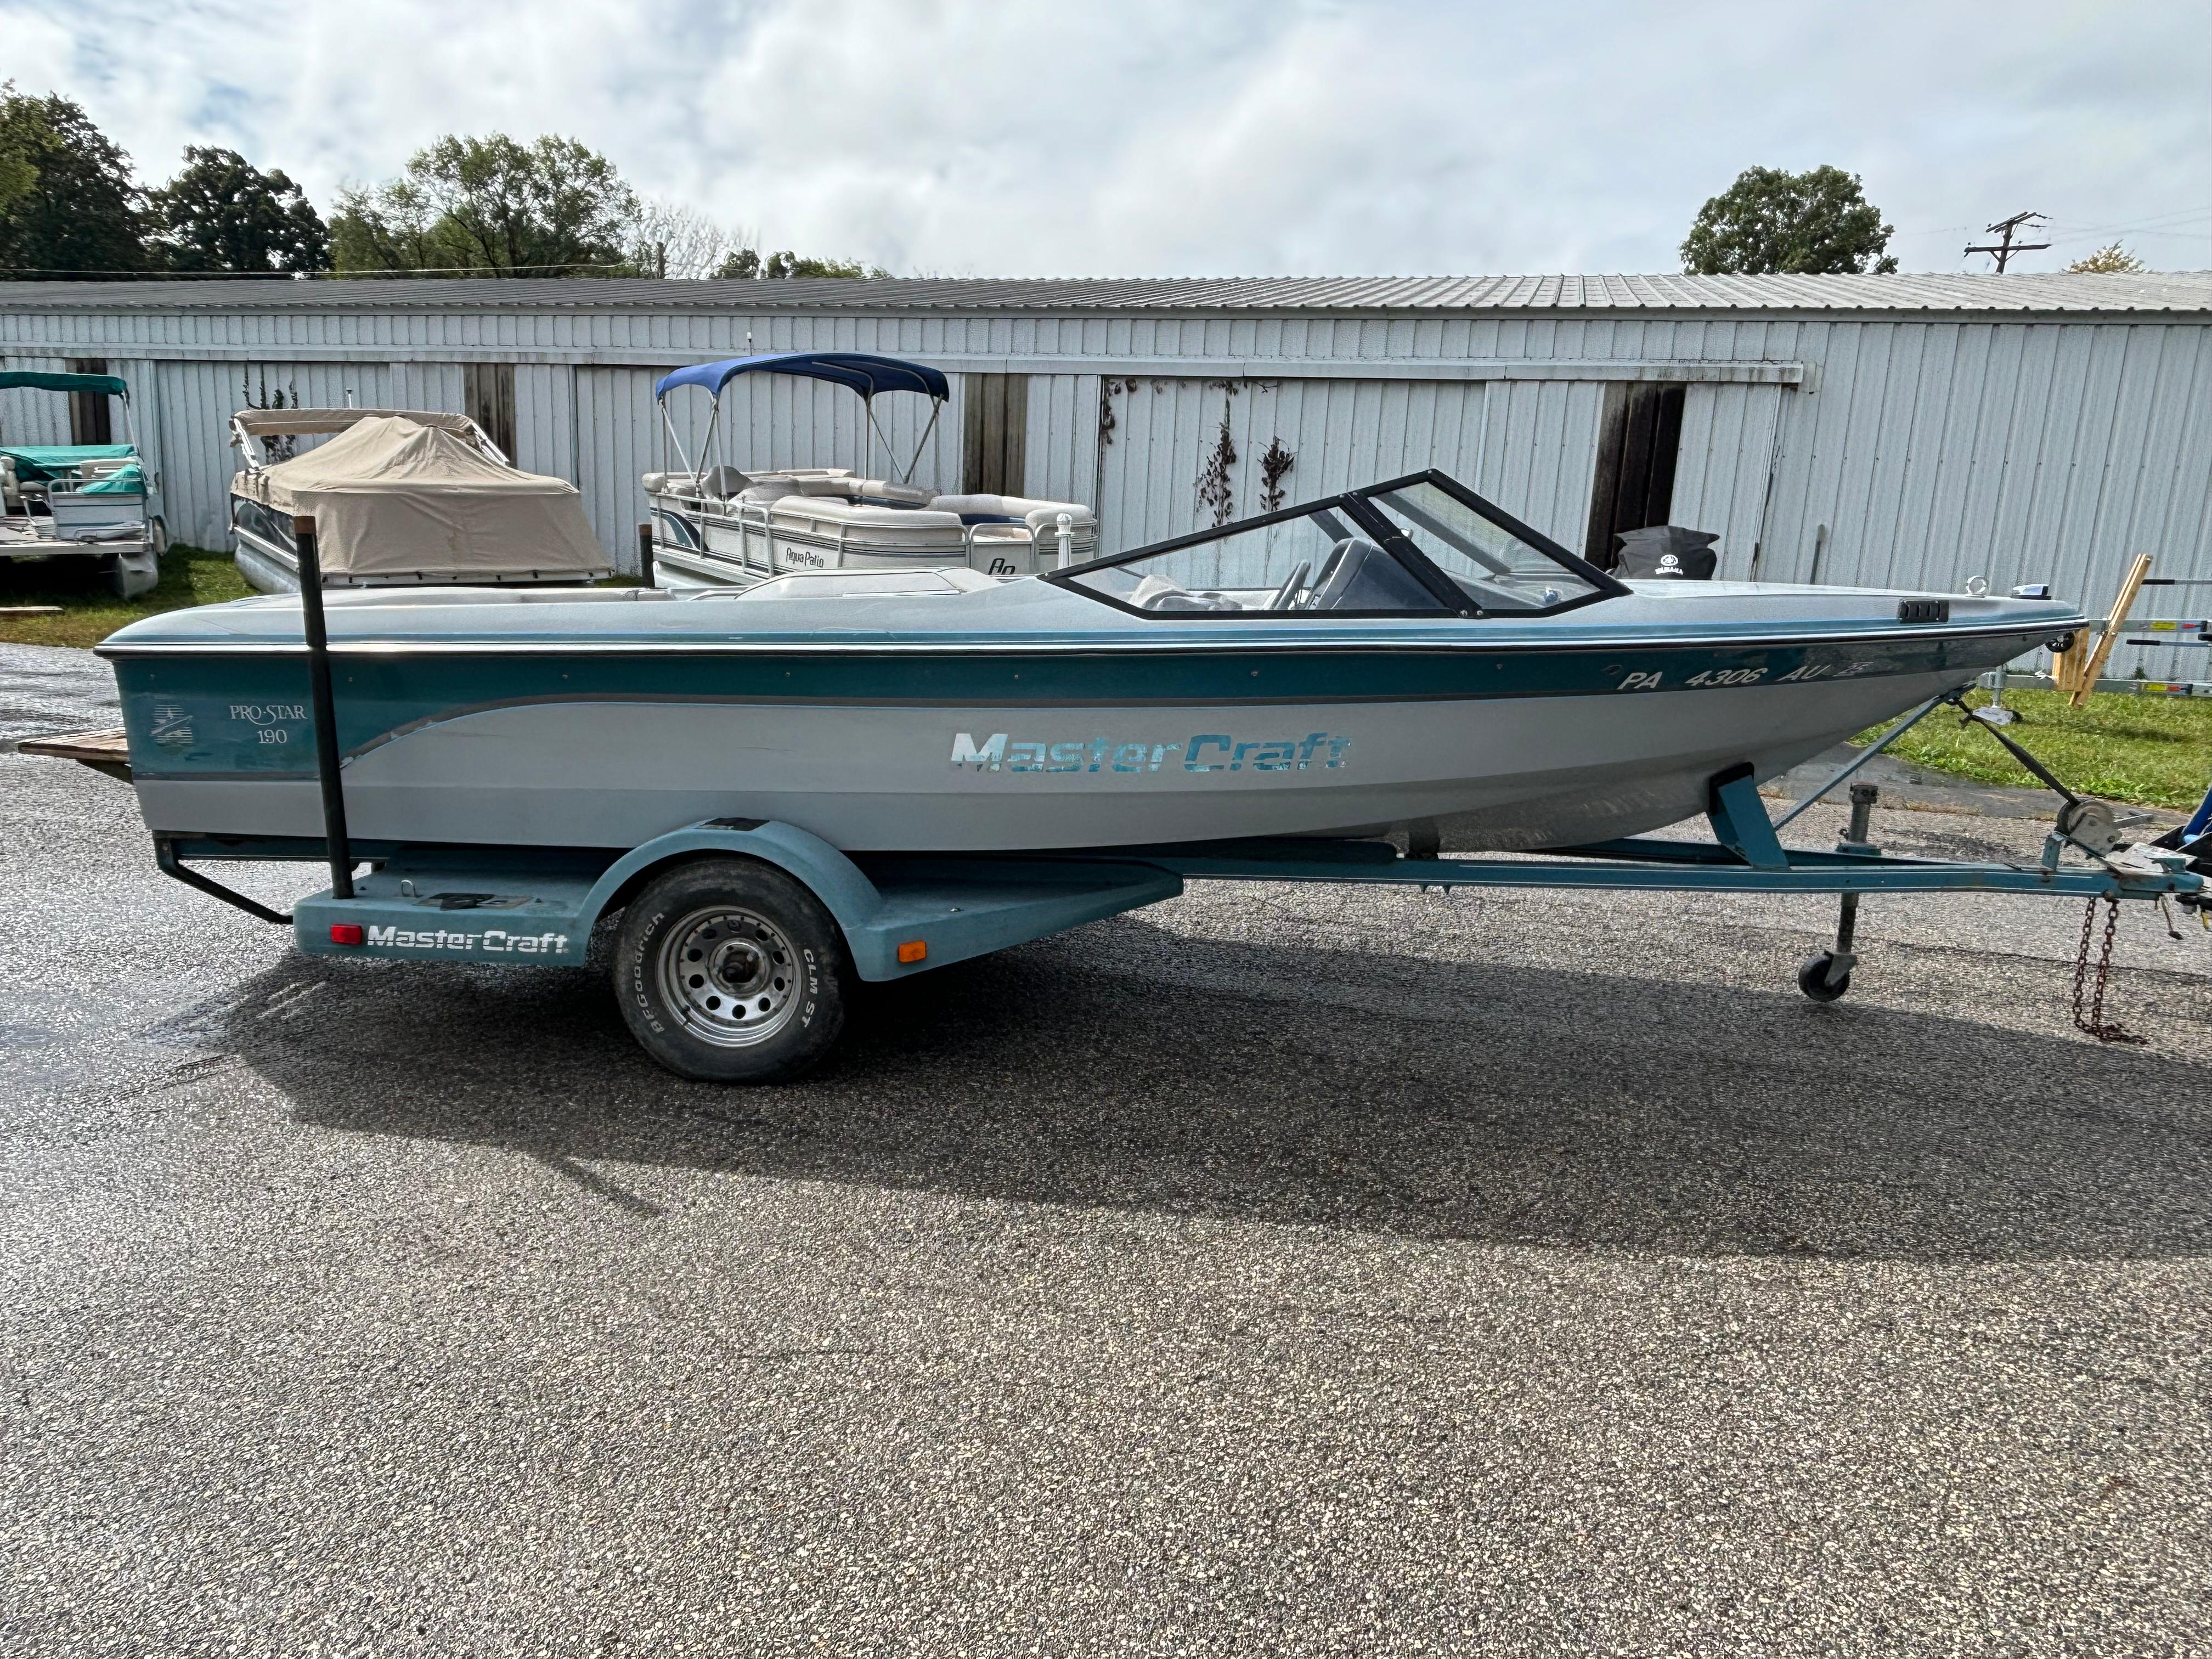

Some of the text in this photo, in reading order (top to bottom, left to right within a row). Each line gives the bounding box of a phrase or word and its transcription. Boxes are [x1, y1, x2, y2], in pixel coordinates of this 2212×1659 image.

[1617, 665, 1831, 690] PA 4306 AU
[951, 732, 1352, 772] MasterCraft
[367, 926, 568, 954] MasterCraft
